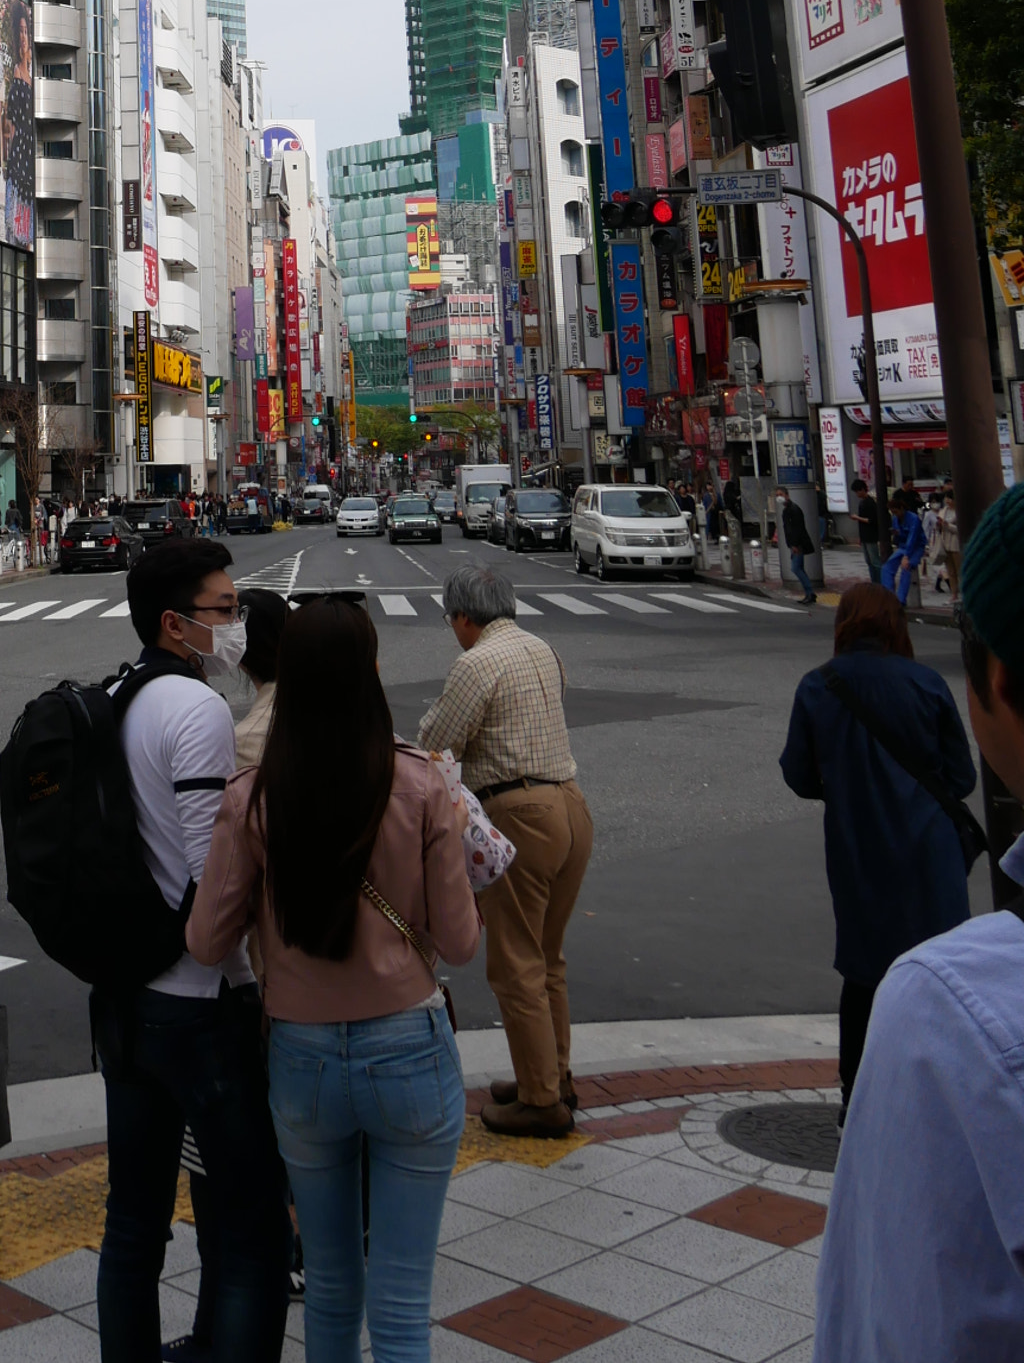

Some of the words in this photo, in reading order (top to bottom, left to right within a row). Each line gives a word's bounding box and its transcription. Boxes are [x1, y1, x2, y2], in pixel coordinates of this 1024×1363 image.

[680, 56, 695, 68] 5F
[701, 173, 777, 192] 道玄坂二丁目
[842, 152, 897, 198] カメラの
[705, 192, 741, 202] Dogenzaka
[744, 190, 776, 200] 2-chome
[843, 182, 925, 246] キタムラ
[522, 248, 532, 264] 麻雀
[702, 262, 721, 287] 24
[704, 286, 723, 295] OPEN
[239, 329, 252, 351] A2
[618, 261, 648, 408] カラオケ館
[906, 347, 926, 364] TAX
[908, 364, 928, 379] FREE
[138, 351, 148, 426] MEGAドンキ
[537, 375, 552, 448] クロサワ楽器店
